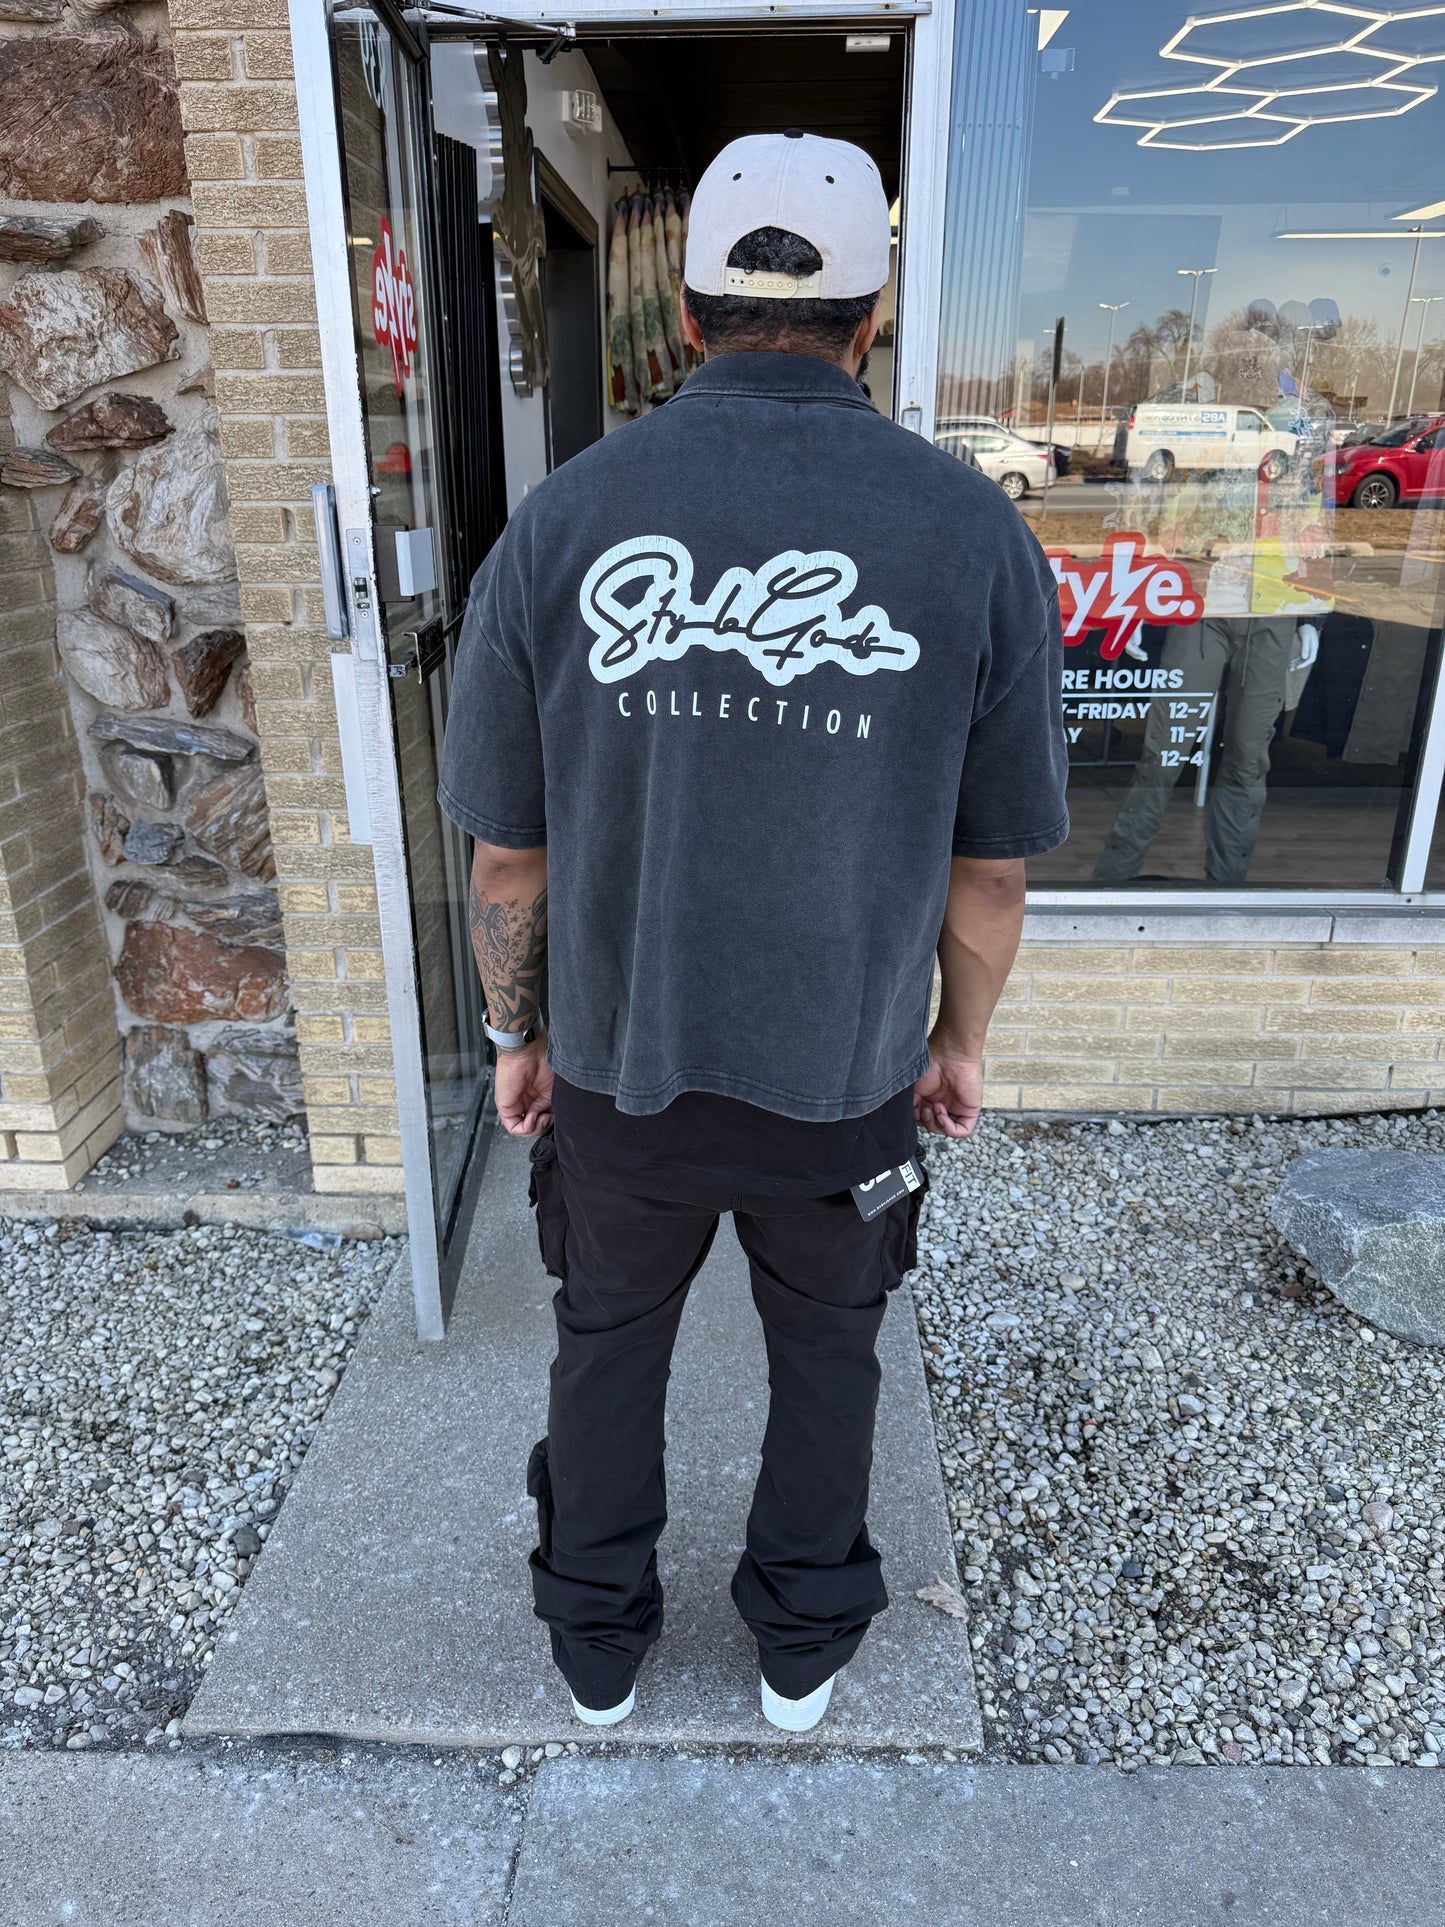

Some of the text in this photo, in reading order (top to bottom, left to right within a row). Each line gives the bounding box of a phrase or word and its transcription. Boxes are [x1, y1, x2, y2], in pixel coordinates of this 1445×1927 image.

[1094, 668, 1184, 689] HOURS
[618, 690, 872, 739] COLLECTION
[1169, 701, 1211, 719] 12-7
[1170, 726, 1208, 743] 11-7
[1160, 750, 1204, 767] 12-4
[901, 1164, 918, 1185] FIT
